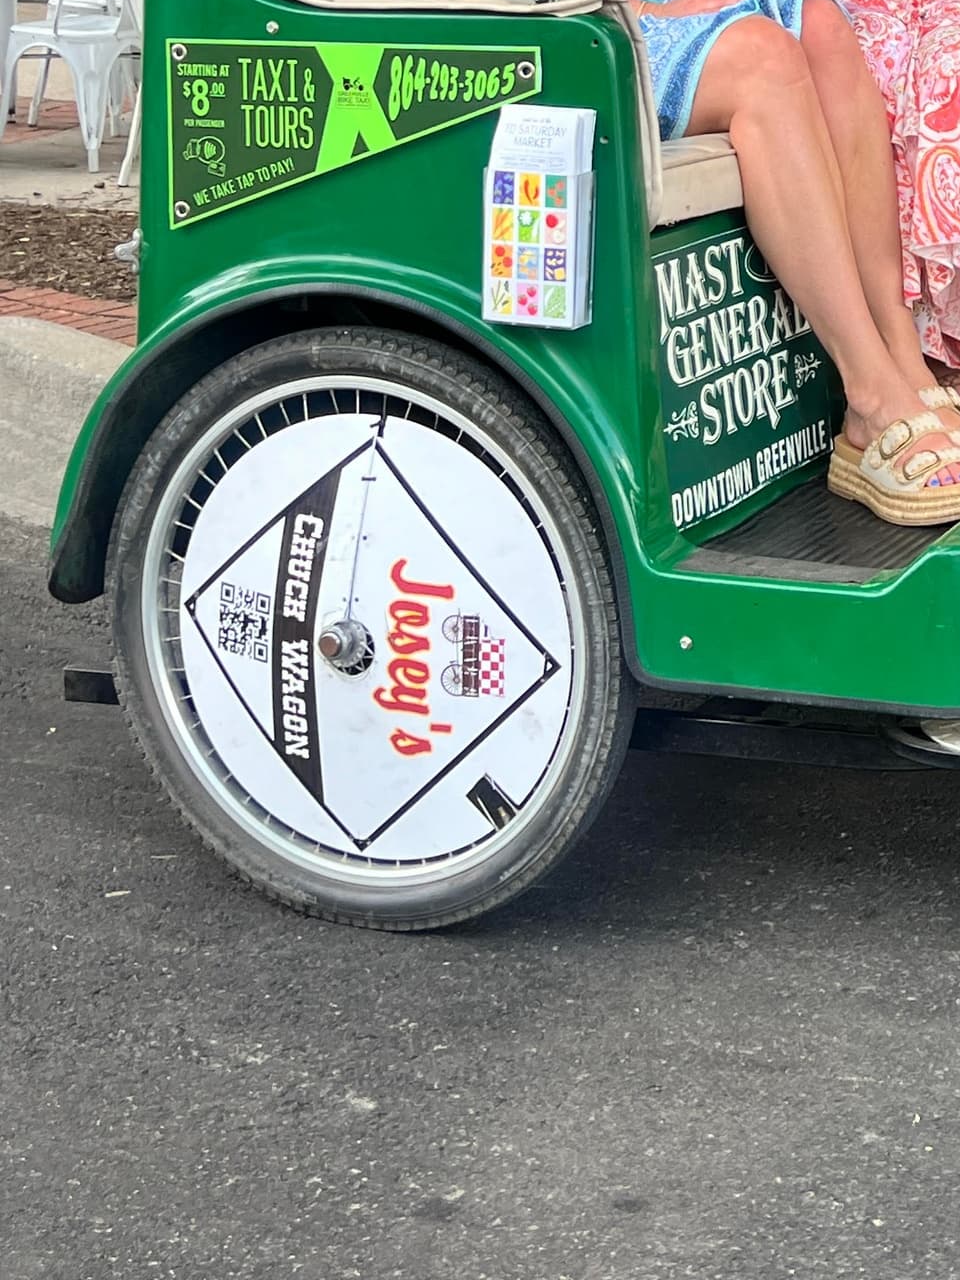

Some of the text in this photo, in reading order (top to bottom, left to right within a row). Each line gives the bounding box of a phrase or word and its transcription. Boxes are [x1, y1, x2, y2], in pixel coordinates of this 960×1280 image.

[177, 63, 231, 78] STARTING AT
[238, 57, 316, 103] TAXI &
[388, 54, 517, 122] 864-293-3065
[241, 104, 315, 150] TOURS
[514, 136, 552, 149] MARKET
[519, 123, 568, 138] SATURDAY
[193, 157, 296, 207] WE TAKE TAP TO PAY!
[654, 237, 745, 338] MAST
[666, 287, 814, 388] GENERAL
[700, 349, 798, 446] STORE
[671, 419, 828, 528] DOWNTOWN GREENVILLE
[280, 513, 325, 759] CHUCK WAGON
[373, 557, 456, 757] Josey's
